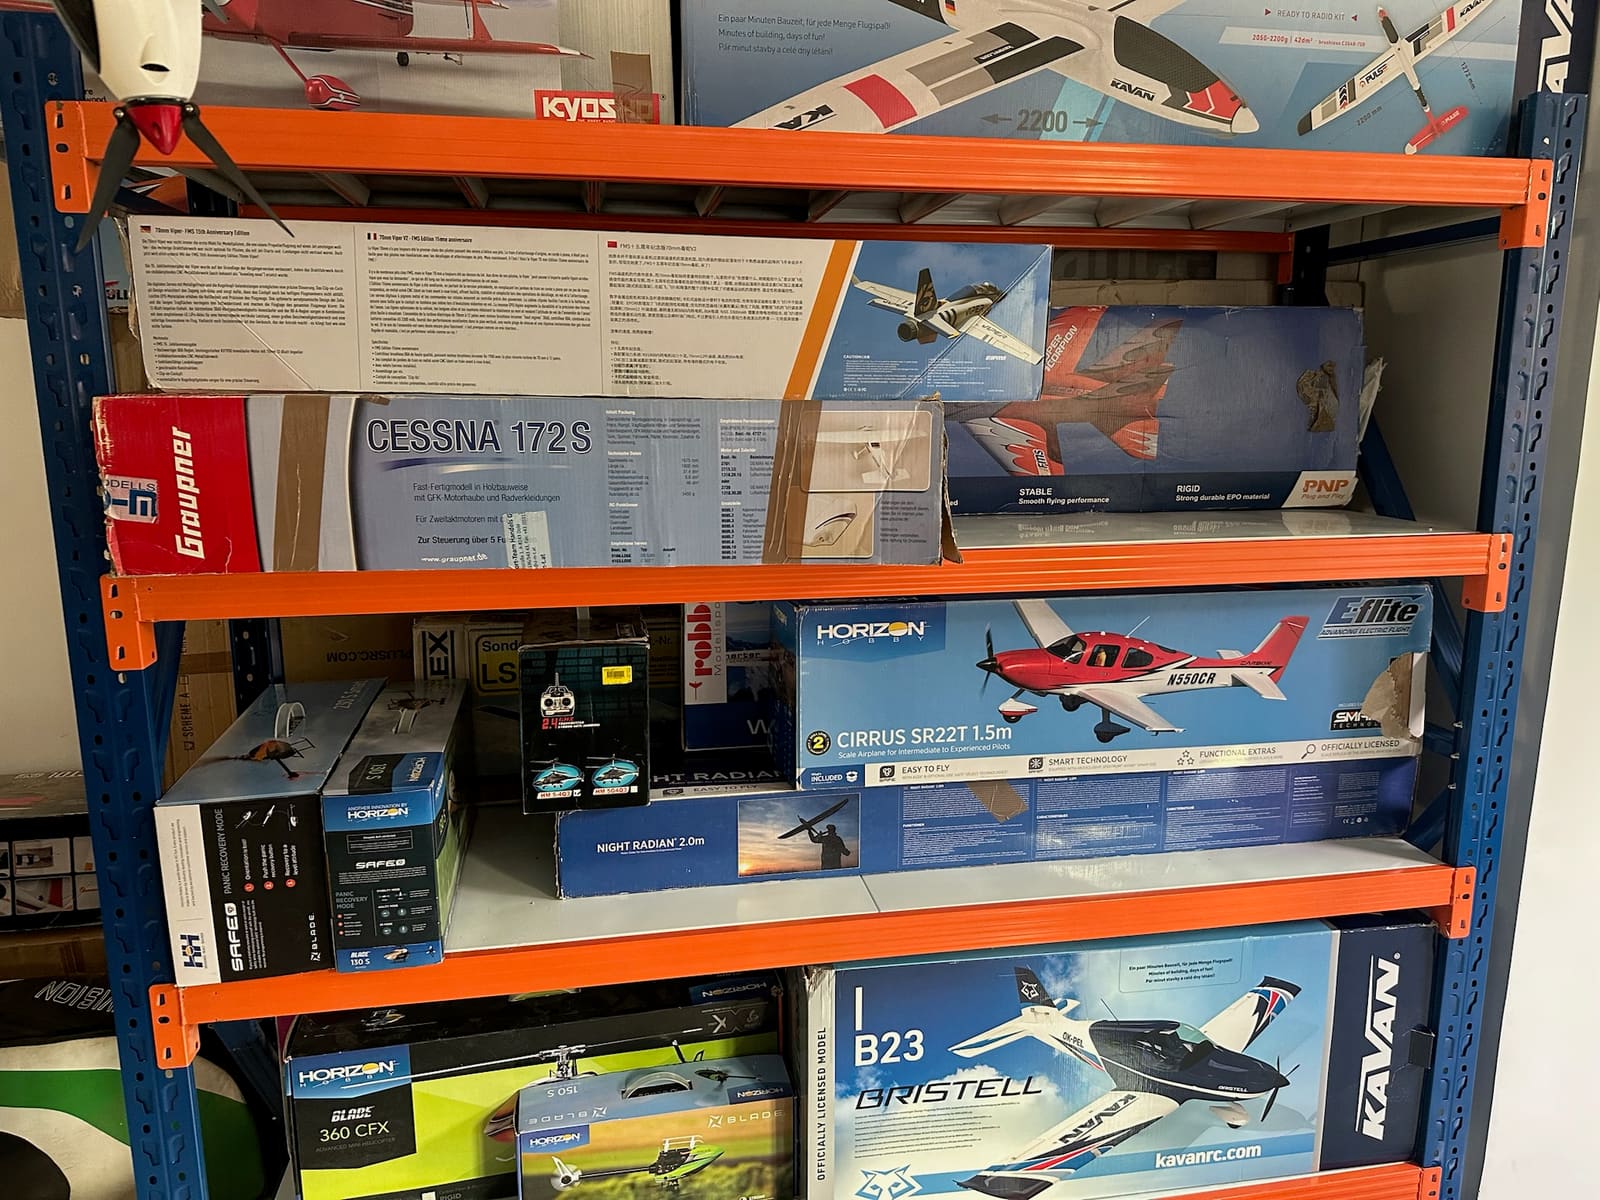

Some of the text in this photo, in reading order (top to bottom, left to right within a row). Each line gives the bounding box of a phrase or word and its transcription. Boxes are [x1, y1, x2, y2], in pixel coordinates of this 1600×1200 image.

[1277, 9, 1345, 21] READY TO RADIO KIT
[718, 29, 747, 38] Minutes
[1110, 78, 1156, 102] KAVAN
[1017, 109, 1068, 133] 2200
[367, 419, 502, 454] CESSNA
[511, 420, 566, 454] 172
[571, 420, 592, 454] S
[172, 426, 206, 560] Graupner
[413, 482, 529, 492] Fast-Fertigmodell in Holzbauweise
[1019, 488, 1053, 496] STABLE
[1176, 484, 1201, 493] RIGID
[1302, 479, 1350, 493] PNP
[414, 494, 560, 504] mit GFK-Motorhaube und Radverkleidungen
[1018, 496, 1110, 506] Smooth flying performance
[1176, 494, 1199, 502] Strong
[1200, 493, 1226, 502] durable
[1226, 493, 1242, 501] EPO
[416, 514, 499, 523] Für Zweitaktmotoren mit
[418, 536, 496, 546] Zur Steuerung über 5
[511, 544, 520, 570] ort-Team
[1325, 596, 1420, 625] E-flite
[687, 602, 712, 676] robb
[817, 621, 926, 641] HORIZON
[429, 630, 448, 679] EX
[481, 662, 517, 685] LS
[1167, 672, 1217, 686] N550CR
[180, 700, 194, 738] SCHEME
[1334, 711, 1375, 723] SMA
[812, 736, 825, 748] 2
[837, 724, 1012, 748] CIRRUS SR22T 1.5m
[838, 751, 857, 760] Scale
[857, 750, 886, 760] Airplane
[898, 747, 941, 756] Intermediate
[950, 744, 992, 754] Experienced
[992, 742, 1011, 751] Pilots
[1200, 746, 1276, 760] FUNCTIONAL EXTRAS
[1321, 739, 1400, 752] OFFICIALLY LICENSED
[902, 766, 923, 774] EASY
[924, 765, 935, 773] TO
[936, 764, 950, 772] FLY
[1048, 755, 1128, 766] SMART TECHNOLOGY
[811, 774, 844, 783] INCLUDED
[348, 808, 408, 820] HORIZON
[214, 808, 232, 894] PANIC RECOVERY MODE
[597, 840, 631, 854] NIGHT
[632, 838, 675, 851] RADIAN
[679, 836, 705, 848] 2.0m
[308, 914, 318, 950] BLADE
[854, 1030, 925, 1067] B23
[1356, 954, 1400, 1142] KAVAN
[299, 1060, 395, 1084] HORIZON
[855, 1076, 1043, 1110] BRISTELL
[816, 1026, 826, 1181] OFFICIALLY LICENSED MODEL
[331, 1106, 376, 1122] BLADE
[726, 1110, 784, 1124] BLADE
[1058, 1094, 1137, 1145] KAVAN
[320, 1120, 390, 1142] 360 CFX
[530, 1132, 580, 1147] HORIZON
[1155, 1143, 1262, 1170] kavanrc.com
